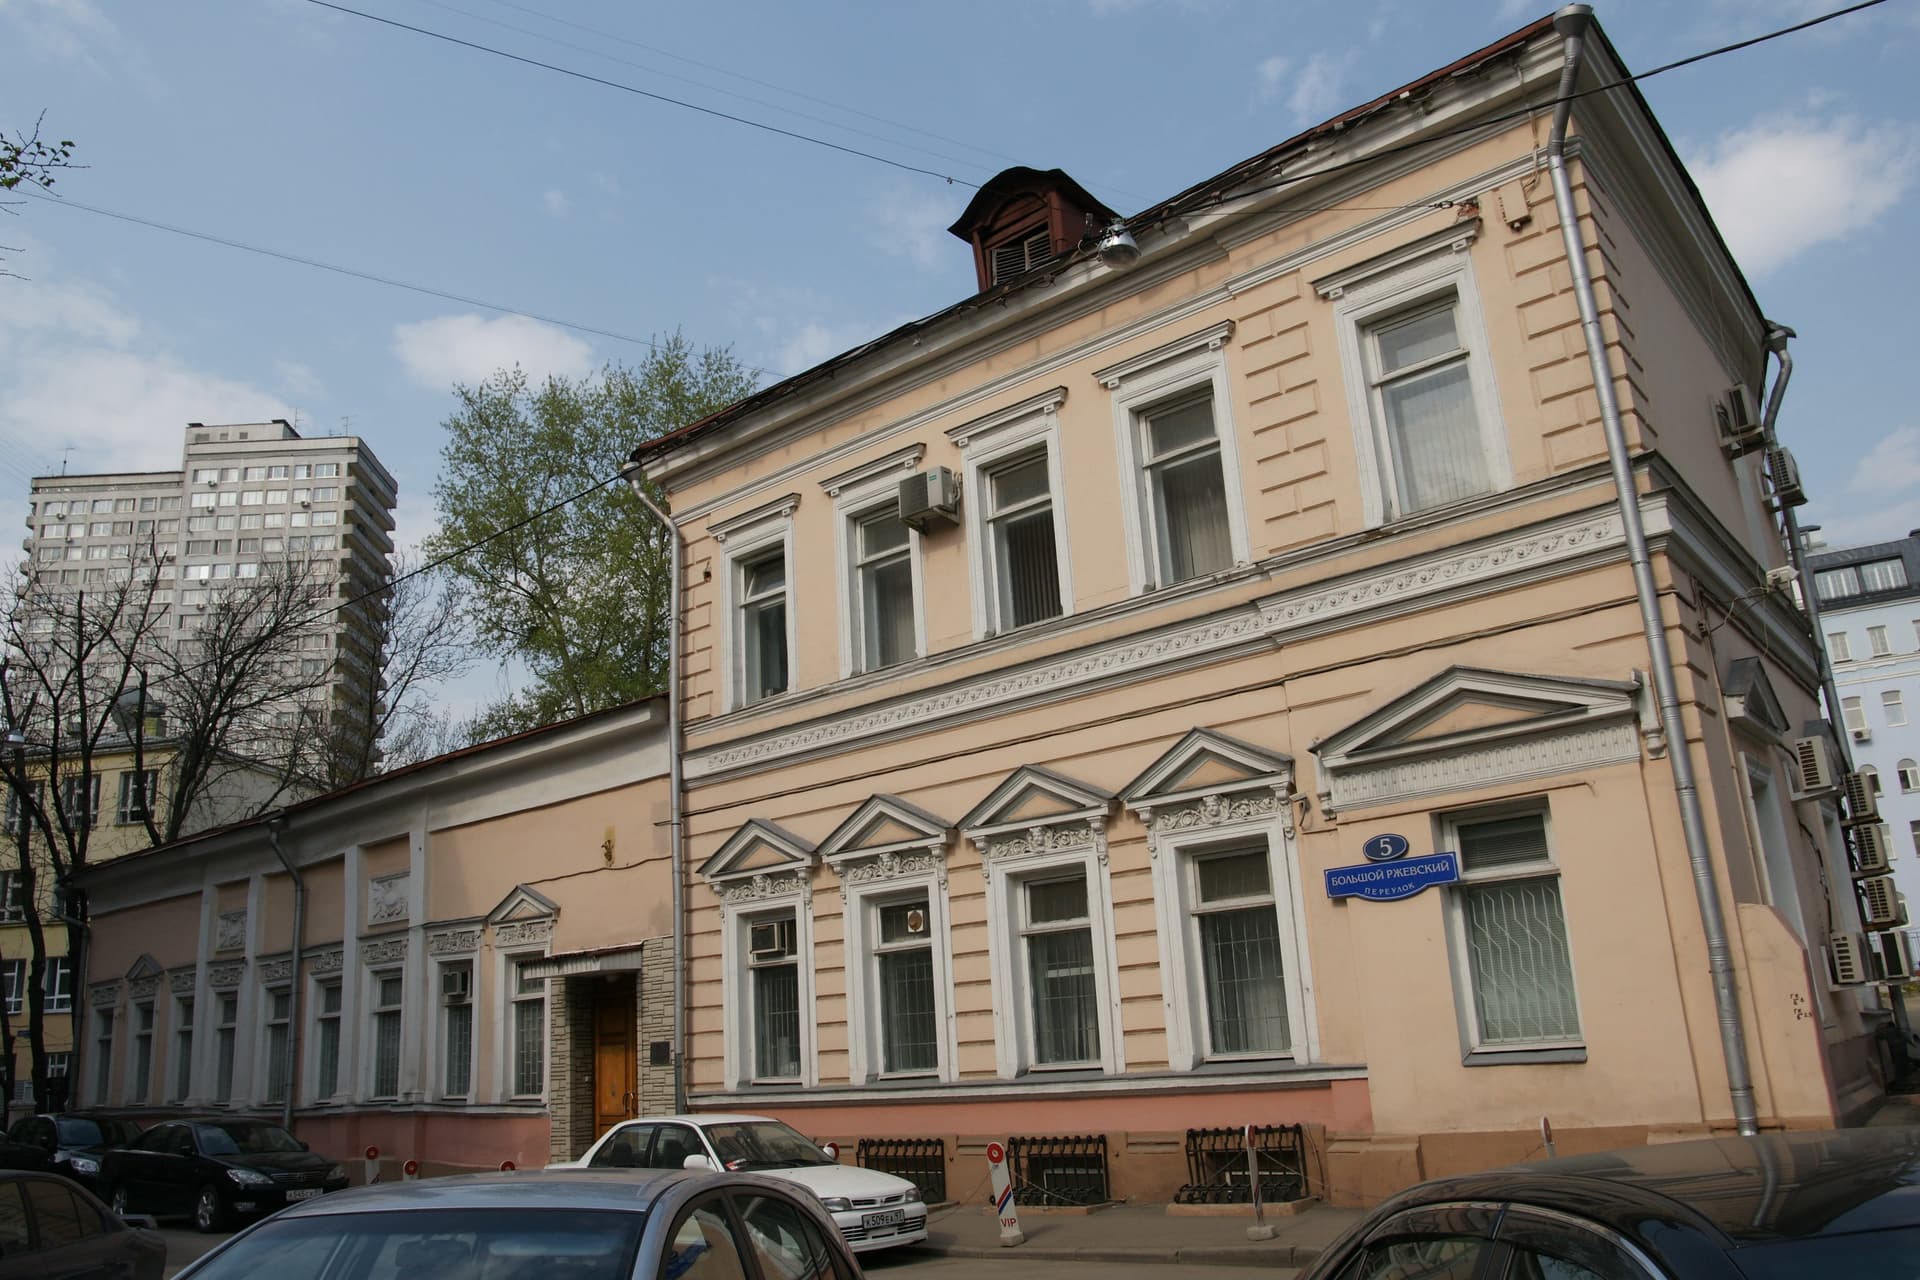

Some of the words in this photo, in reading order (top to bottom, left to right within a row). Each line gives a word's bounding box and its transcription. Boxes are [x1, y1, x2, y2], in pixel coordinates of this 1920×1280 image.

[1379, 838, 1393, 857] 5
[1331, 869, 1385, 887] БОЛЬШОЙ
[1386, 861, 1450, 879] РЖЕВСКИЙ
[1364, 882, 1415, 895] ПЕРЕУЛОК
[1000, 1217, 1017, 1228] VIP
